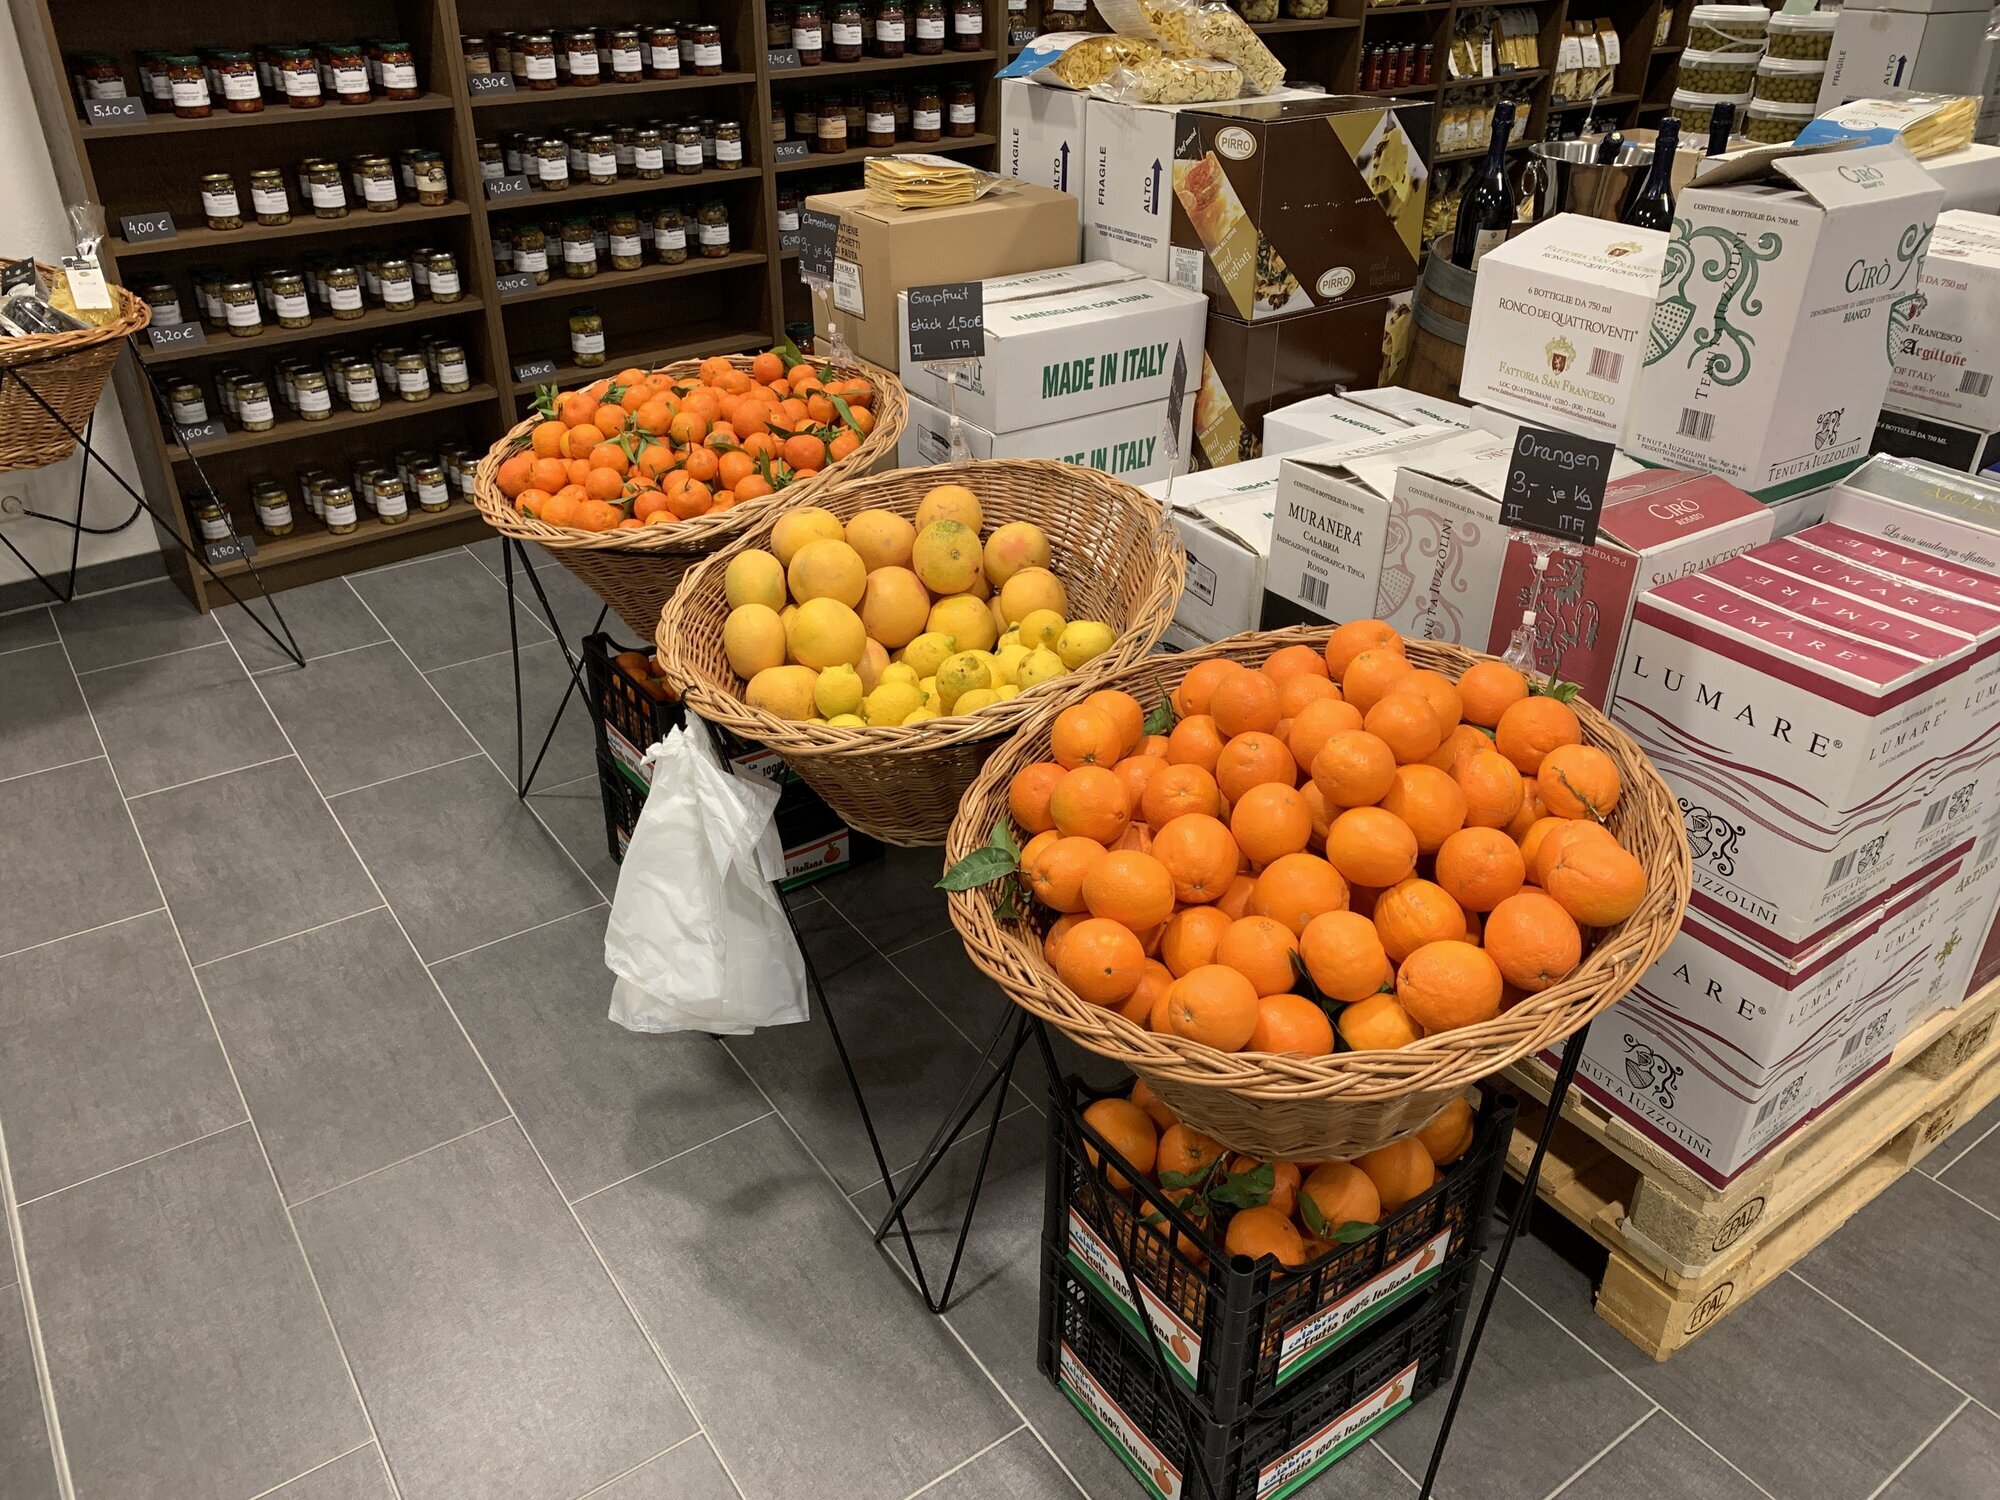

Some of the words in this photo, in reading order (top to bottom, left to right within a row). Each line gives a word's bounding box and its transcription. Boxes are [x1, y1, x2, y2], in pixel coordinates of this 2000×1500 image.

[1832, 50, 1847, 87] FRAGILE
[1883, 54, 1897, 86] ALTO
[1221, 137, 1251, 152] PIRRO
[1053, 158, 1061, 191] ALTO
[1098, 146, 1107, 206] FRAGILE
[1838, 165, 1884, 184] CIRÒ
[1143, 176, 1152, 214] ALTO
[802, 213, 836, 232] Clementinen
[1693, 203, 1726, 215] CONTIENE
[1731, 210, 1765, 222] BOTTIGLIE
[1766, 215, 1776, 223] DA
[1777, 216, 1789, 226] 750
[1789, 218, 1800, 227] ML
[1217, 248, 1233, 273] mal
[1223, 249, 1252, 285] tagliati
[1845, 258, 1891, 293] CIRÒ
[910, 286, 969, 306] Grapfruit
[1322, 275, 1350, 290] PIRRO
[1925, 275, 1939, 286] DA
[1940, 278, 1956, 289] 750
[1956, 282, 1968, 291] ml
[1010, 305, 1091, 322] MANEGGIARE
[1091, 299, 1120, 311] CON
[1118, 293, 1154, 304] CURA
[1499, 297, 1537, 317] RONCO
[1537, 309, 1551, 320] DEI
[1527, 286, 1533, 294] 6
[1533, 287, 1574, 304] BOTTIGLIE
[1575, 297, 1587, 307] DA
[1588, 301, 1601, 311] 750
[1601, 306, 1612, 314] ml
[1843, 307, 1871, 323] BIANCO
[1695, 326, 1725, 400] TENUTA
[1713, 232, 1747, 321] IUZZOLINI
[950, 339, 970, 350] ITA
[1911, 323, 1963, 343] FRANCESCO
[1900, 338, 1968, 366] Argillone
[1042, 356, 1095, 399] MADE
[1099, 352, 1118, 387] IN
[1121, 342, 1169, 382] ITALY
[1499, 360, 1541, 384] FATTORIA
[1541, 373, 1560, 390] SAN
[1561, 378, 1616, 406] FRANCESCO
[1893, 366, 1907, 375] OF
[1908, 367, 1936, 382] ITALY
[1511, 383, 1552, 402] QUATTROMANI
[1554, 397, 1568, 407] CIRÒ
[1586, 407, 1606, 418] ITALIA
[1928, 388, 1951, 398] ITALIA
[1330, 413, 1386, 436] MANEGGIA
[1885, 423, 1917, 437] BOTTIGLIE
[1916, 430, 1926, 439] DA
[1091, 447, 1108, 473] IN
[1111, 436, 1157, 474] ITALY
[1518, 434, 1599, 470] Orangen
[1636, 433, 1668, 449] TENUTA
[1668, 443, 1706, 460] IUZZOLINI
[1641, 443, 1669, 458] PRODOTTO
[1677, 453, 1695, 465] ITALIA
[1768, 459, 1810, 482] TENUTA
[1811, 443, 1862, 468] IUZZOLINI
[1293, 480, 1315, 493] CONTIENE
[1318, 490, 1342, 504] BOTTIGLIE
[1342, 500, 1349, 508] DA
[1408, 486, 1434, 500] CONTIENE
[1438, 495, 1466, 512] BOTTIGLIE
[1466, 507, 1475, 515] DA
[1475, 509, 1485, 518] 750
[1485, 513, 1494, 522] ML
[1547, 485, 1566, 504] je
[1648, 498, 1700, 520] CIRÒ
[1559, 514, 1585, 532] ITA
[1675, 513, 1705, 526] ROSATO
[1276, 533, 1310, 555] INDICAZIONE
[1310, 548, 1346, 571] GEOGRAFICA
[1346, 565, 1365, 579] TIPICA
[1303, 530, 1340, 554] CALABRIA
[1429, 518, 1454, 595] IUZZOLINI
[1882, 524, 1900, 538] La
[1900, 533, 1916, 544] sua
[1916, 538, 1958, 557] suadenza
[1959, 551, 1996, 569] olfattiva
[1306, 560, 1329, 577] ROSSO
[1599, 550, 1611, 561] DA
[1611, 555, 1620, 564] 75
[1620, 559, 1627, 567] cl
[1652, 569, 1678, 586] SAN
[1424, 595, 1440, 640] NUTA
[792, 858, 823, 876] Italiana
[1954, 856, 1999, 895] ARTINO
[1693, 870, 1778, 926] UZZOLINI
[1629, 1091, 1712, 1159] IUZZOLINI
[1719, 1205, 1755, 1246] EPAL
[1074, 1230, 1108, 1267] calabria
[1303, 1321, 1340, 1350] Frutta
[1341, 1295, 1371, 1325] 100%
[1372, 1272, 1412, 1302] Italiana
[1690, 1289, 1725, 1330] EPAL
[1288, 1312, 1339, 1350] calabria
[1066, 1361, 1097, 1398] calabria
[1099, 1407, 1122, 1438] 100%
[1122, 1432, 1153, 1475] Italiana
[1278, 1457, 1312, 1486] Frutta
[1315, 1431, 1342, 1459] 100%
[1344, 1407, 1382, 1437] Italiana
[1264, 1448, 1313, 1487] calabria
